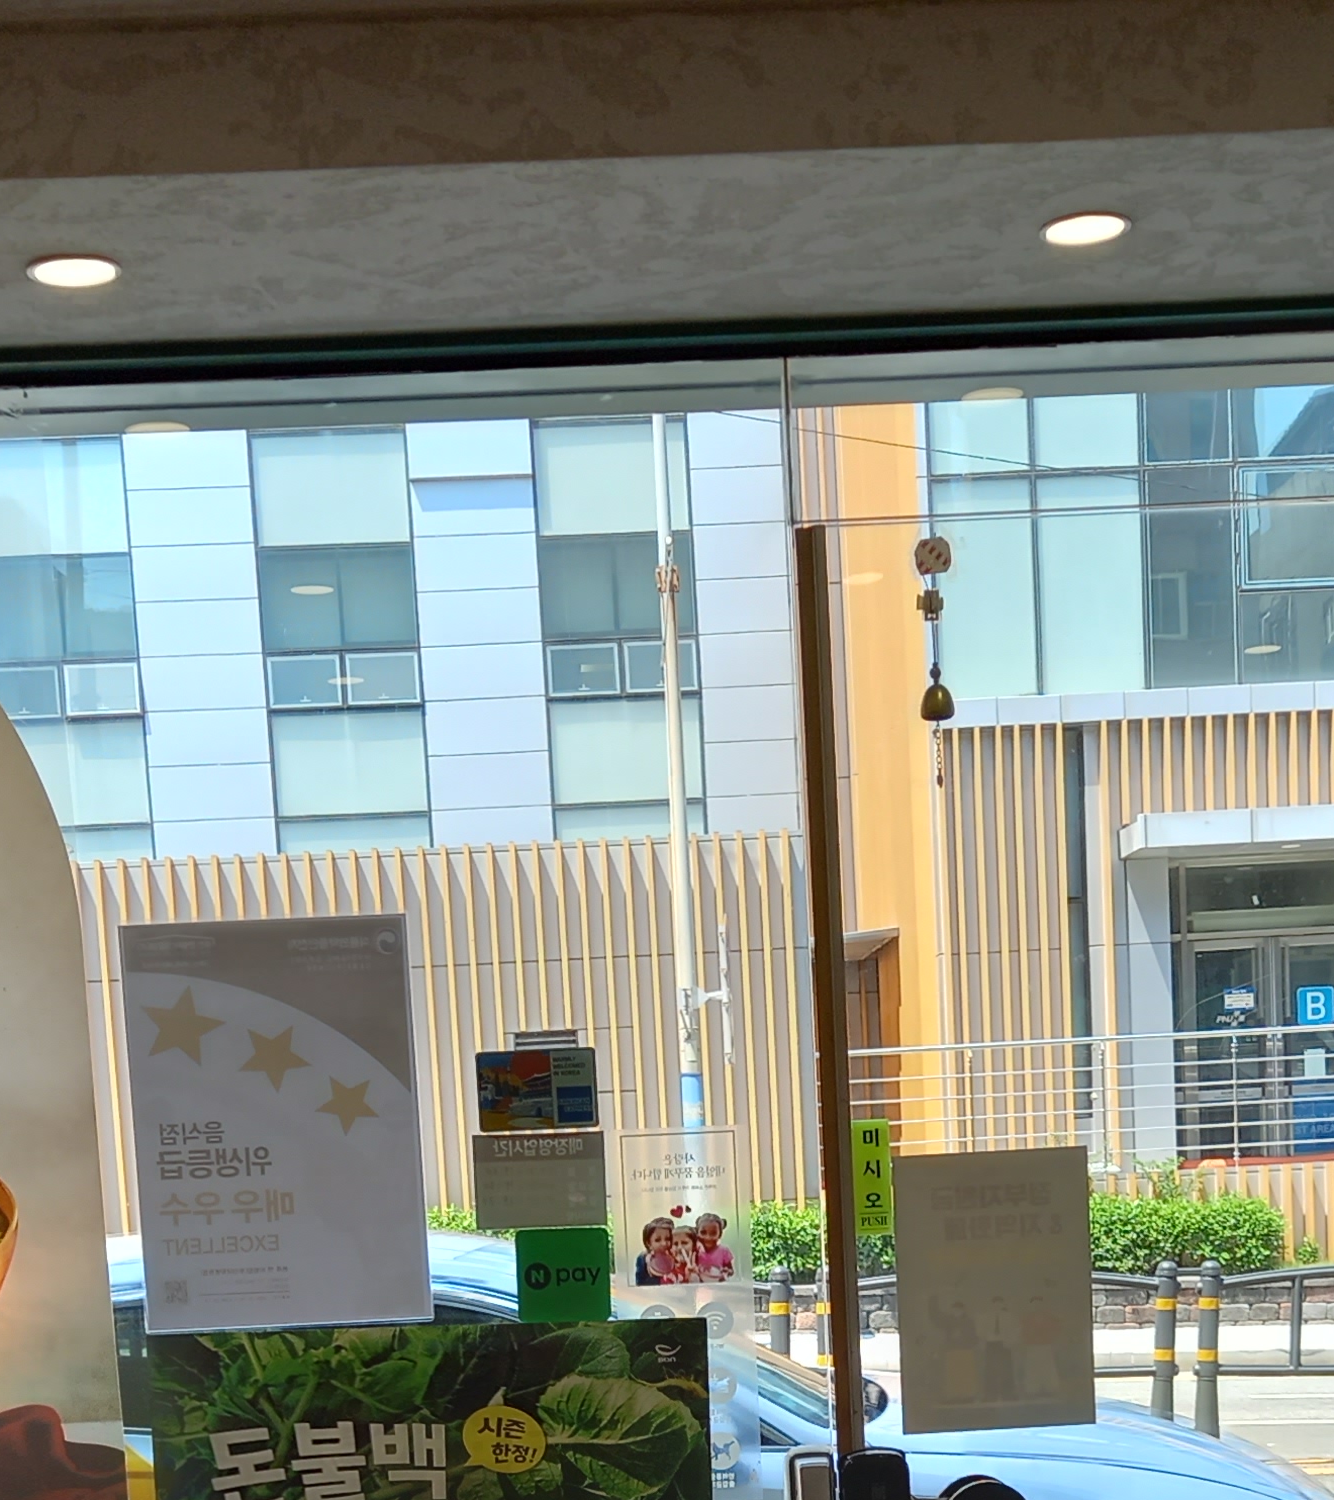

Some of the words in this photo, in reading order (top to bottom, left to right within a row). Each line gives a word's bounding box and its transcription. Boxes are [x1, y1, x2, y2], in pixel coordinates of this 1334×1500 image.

[1306, 990, 1326, 1021] B
[861, 1127, 884, 1210] 미시오
[860, 1214, 889, 1228] PUSH
[555, 1264, 602, 1287] pay
[476, 1416, 528, 1440] 시즌
[491, 1441, 540, 1465] 한정!
